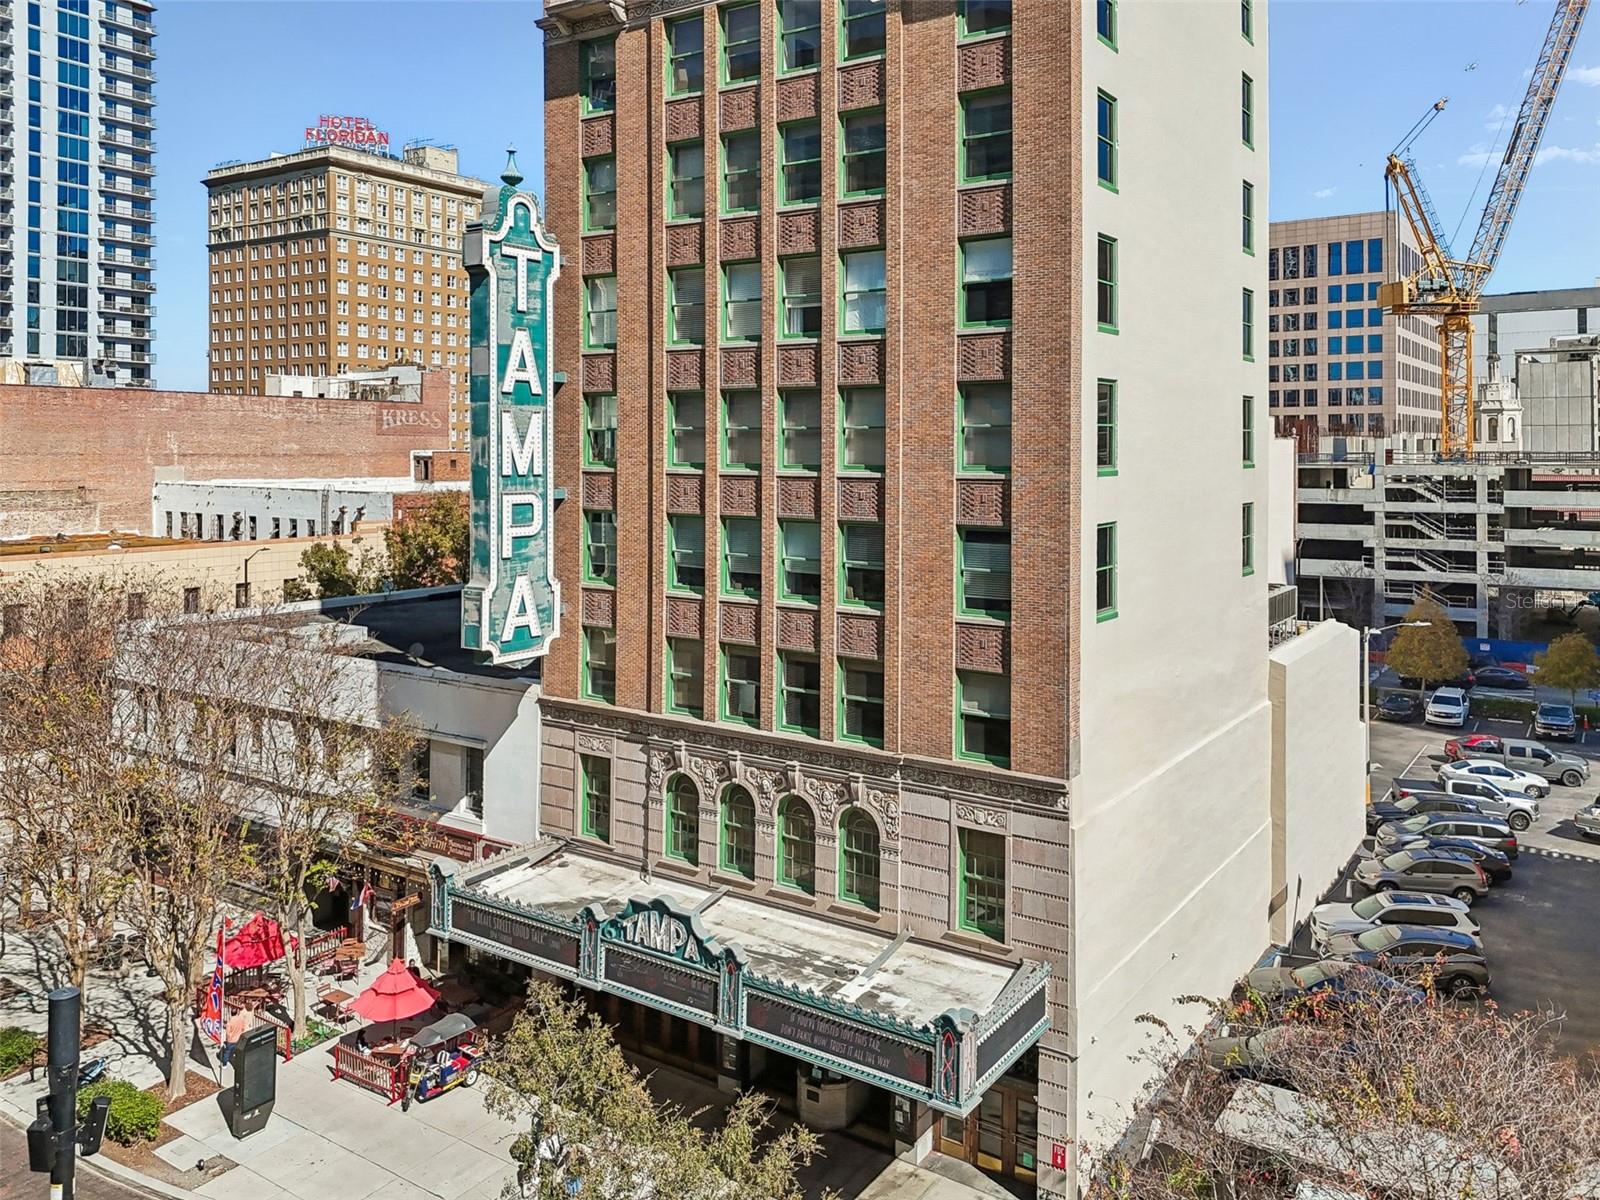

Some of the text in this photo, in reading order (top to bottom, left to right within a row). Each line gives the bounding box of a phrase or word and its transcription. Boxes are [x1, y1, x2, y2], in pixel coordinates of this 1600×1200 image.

[319, 114, 376, 131] HOTEL
[305, 127, 389, 144] FLORIDAN
[382, 409, 442, 429] KRESS
[500, 242, 543, 643] TAMPA
[622, 910, 701, 962] TAMPA
